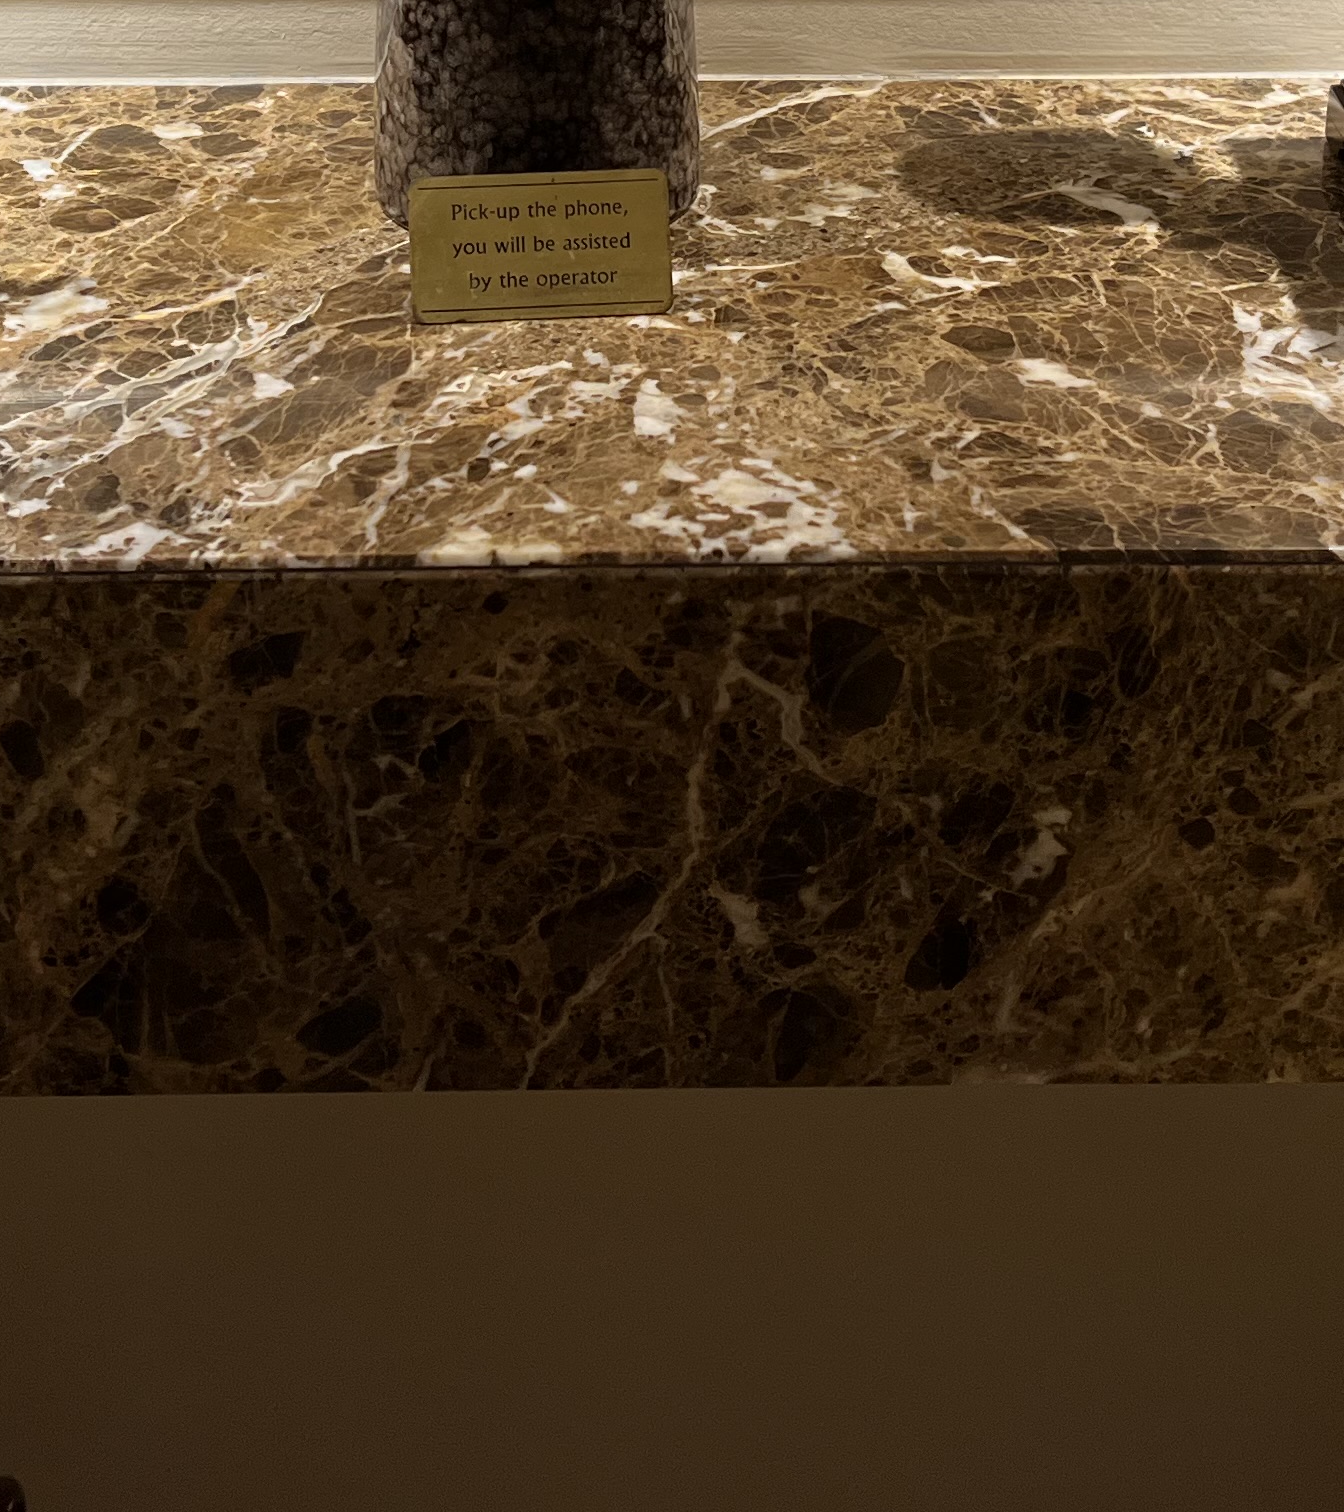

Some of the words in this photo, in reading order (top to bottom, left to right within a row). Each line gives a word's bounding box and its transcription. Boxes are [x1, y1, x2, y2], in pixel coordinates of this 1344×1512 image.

[451, 202, 520, 222] Pick-up
[527, 200, 557, 218] the
[564, 199, 629, 219] phone,
[452, 240, 488, 258] you
[494, 236, 526, 254] will
[533, 235, 555, 252] be
[562, 232, 631, 251] assisted
[468, 272, 492, 292] by
[499, 271, 529, 289] the
[536, 269, 618, 290] operator
